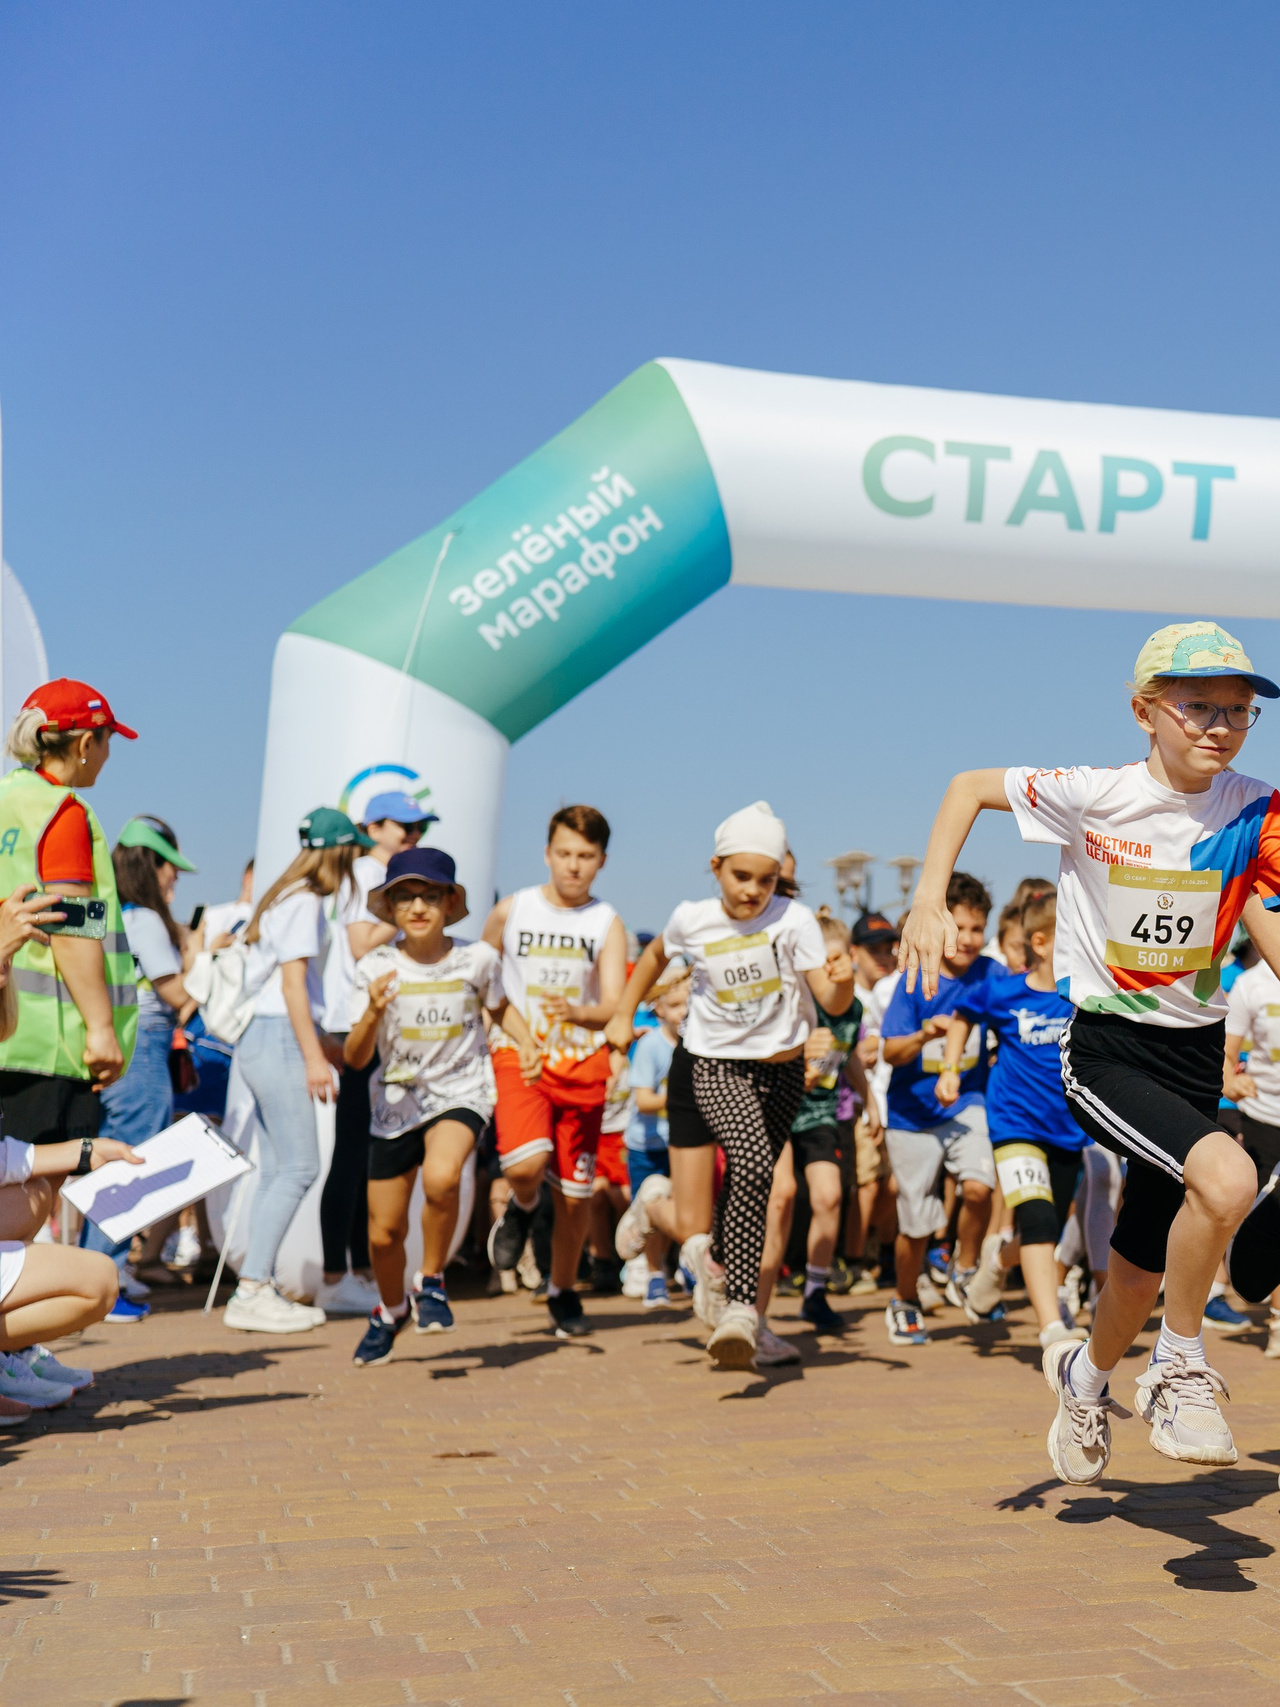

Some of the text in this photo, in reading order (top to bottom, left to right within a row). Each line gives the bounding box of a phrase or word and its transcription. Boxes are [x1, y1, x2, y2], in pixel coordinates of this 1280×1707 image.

[861, 434, 1237, 542] СТАРТ
[447, 465, 638, 618] зелёный
[476, 504, 665, 651] марафон
[1086, 830, 1152, 859] ДОСТИГАЯ
[1130, 913, 1194, 945] 459
[1137, 950, 1168, 967] 500
[724, 963, 762, 986] 085
[416, 1008, 452, 1025] 604
